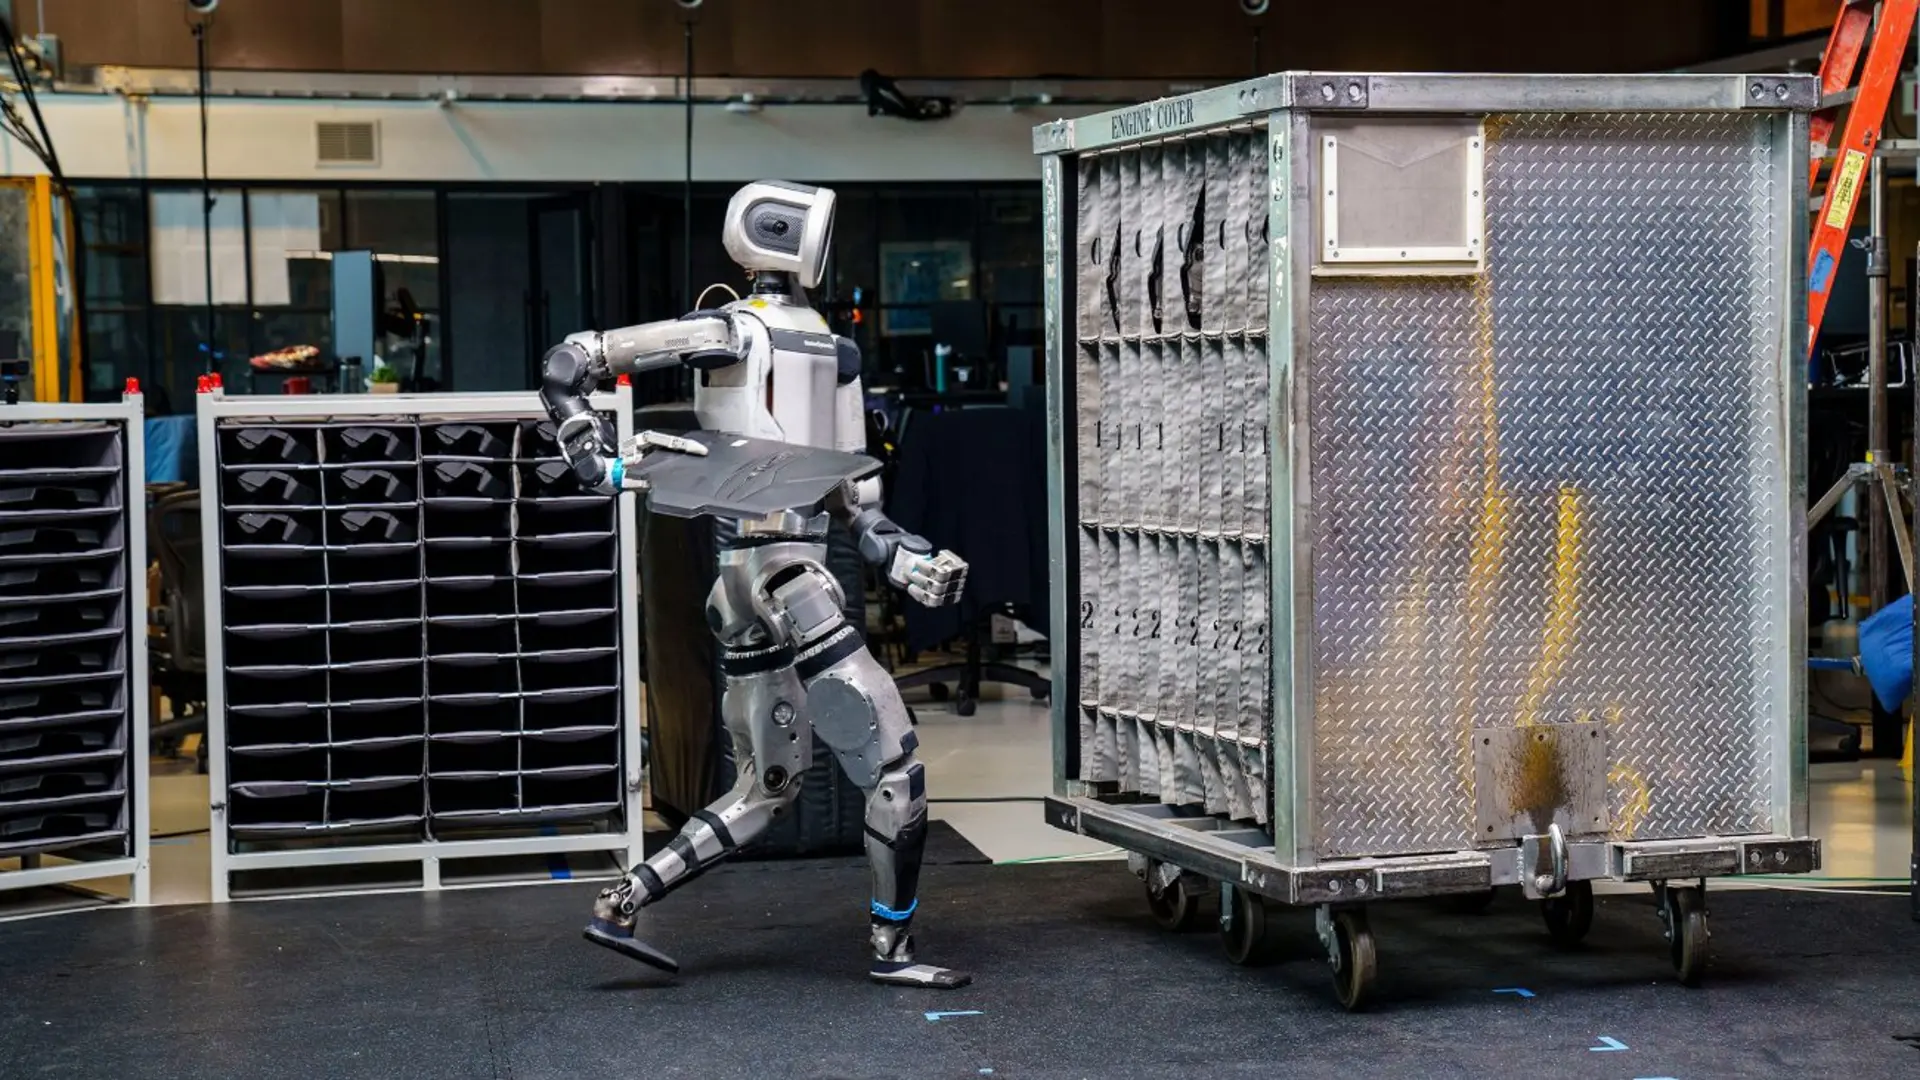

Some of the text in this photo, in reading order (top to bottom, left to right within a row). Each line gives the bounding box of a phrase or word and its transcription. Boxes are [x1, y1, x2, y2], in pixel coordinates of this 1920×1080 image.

[1111, 98, 1194, 140] ENGINE COVER
[1082, 601, 1093, 628] 2
